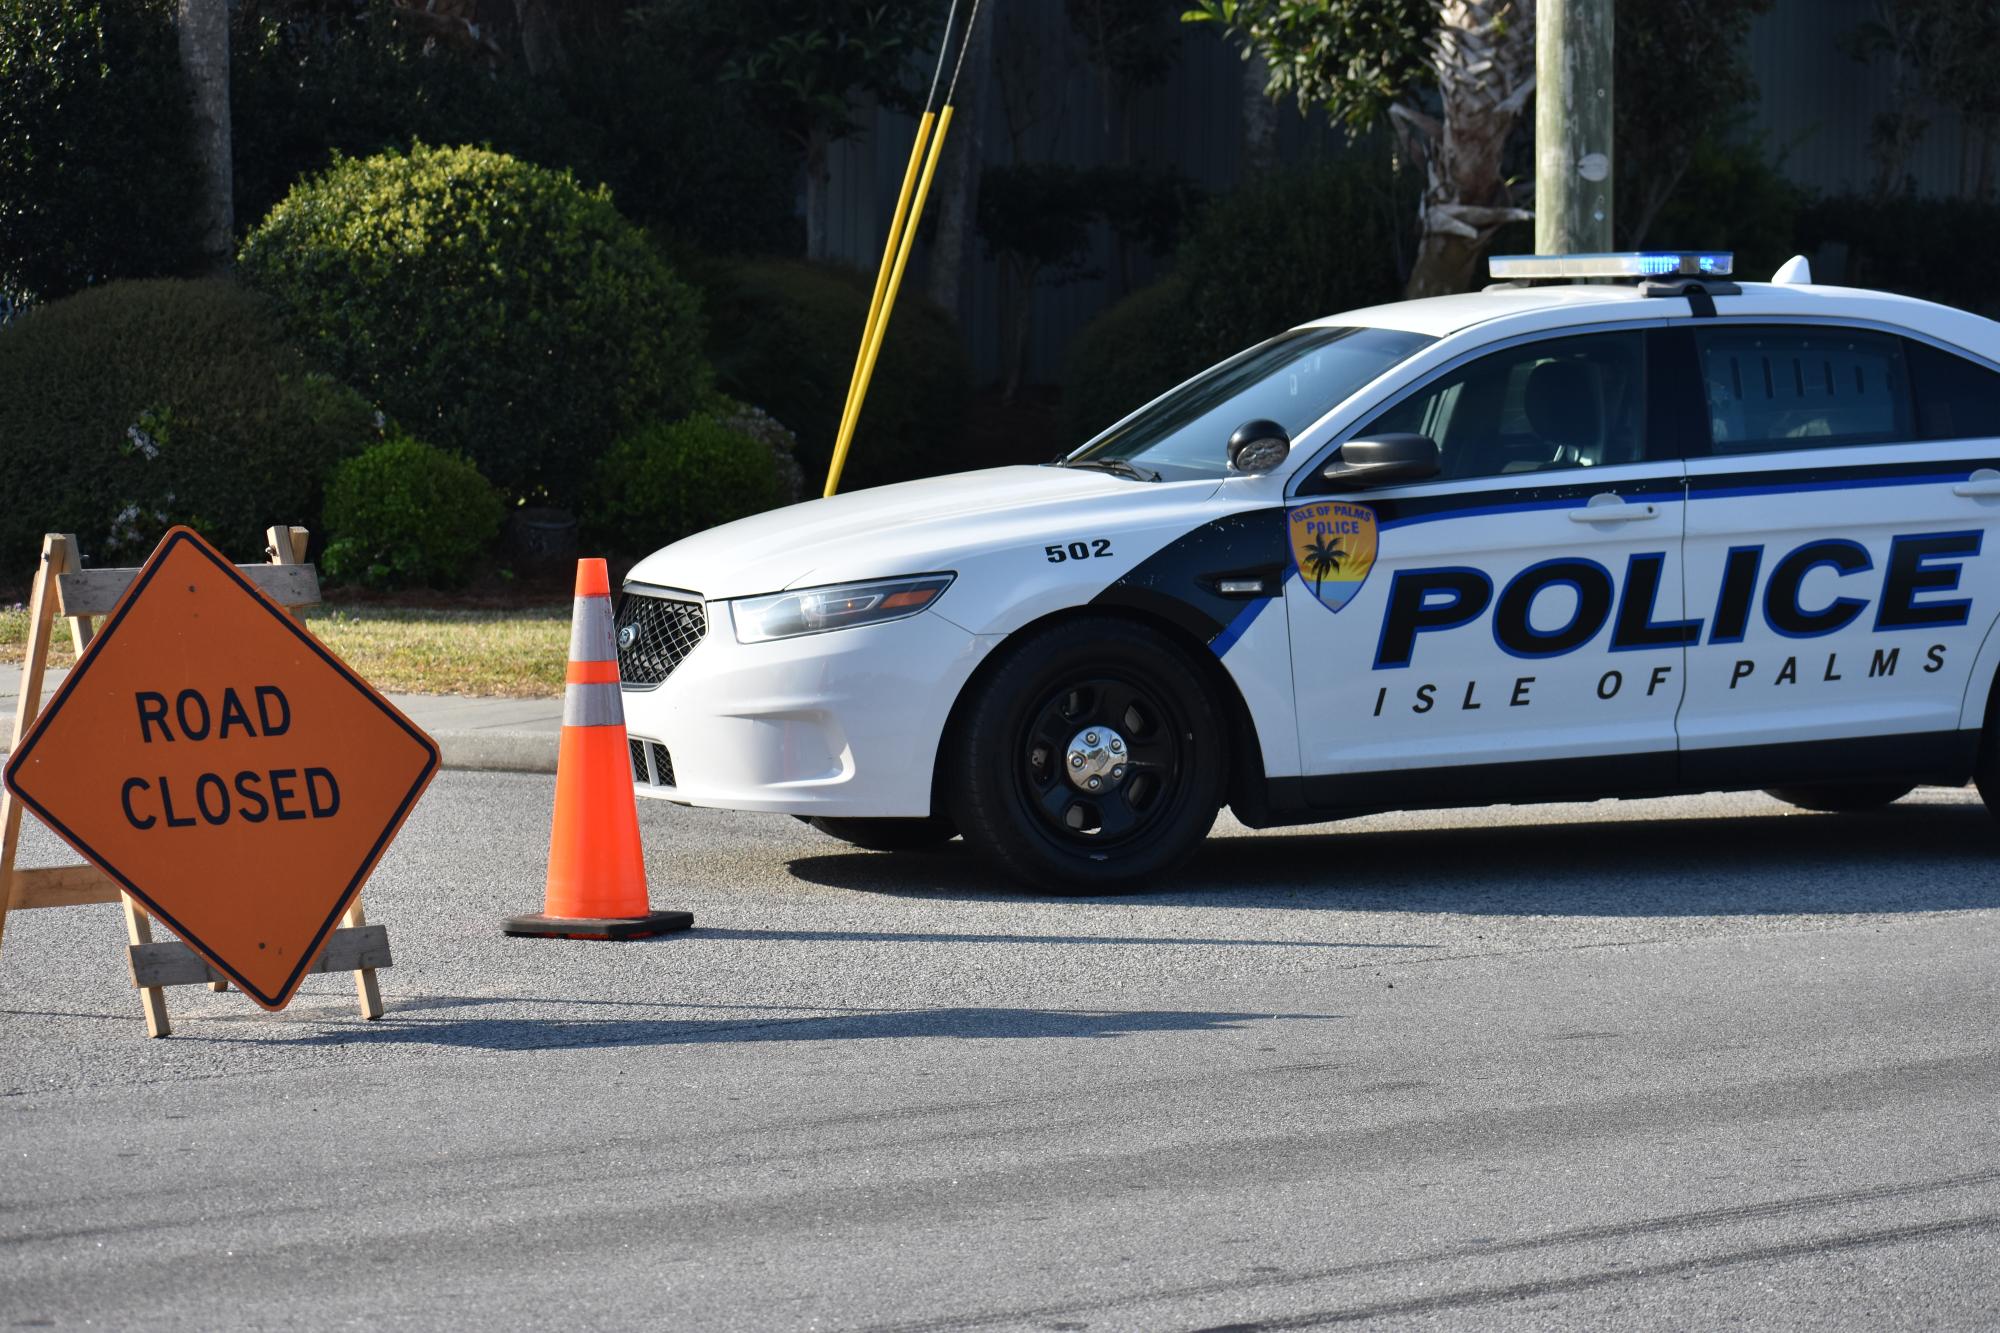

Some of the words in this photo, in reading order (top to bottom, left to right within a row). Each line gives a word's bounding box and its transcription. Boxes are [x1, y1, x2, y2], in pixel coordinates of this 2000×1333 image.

[1291, 508, 1315, 523] ISLE
[1316, 506, 1330, 516] OF
[1334, 505, 1371, 522] PALMS
[1306, 521, 1359, 535] POLICE
[1044, 539, 1114, 563] 502
[1372, 529, 1984, 671] POLICE
[1373, 677, 1536, 716] ISLE
[1596, 665, 1672, 701] OF
[1730, 644, 1947, 690] PALMS
[135, 685, 291, 743] ROAD
[121, 767, 341, 831] CLOSED
